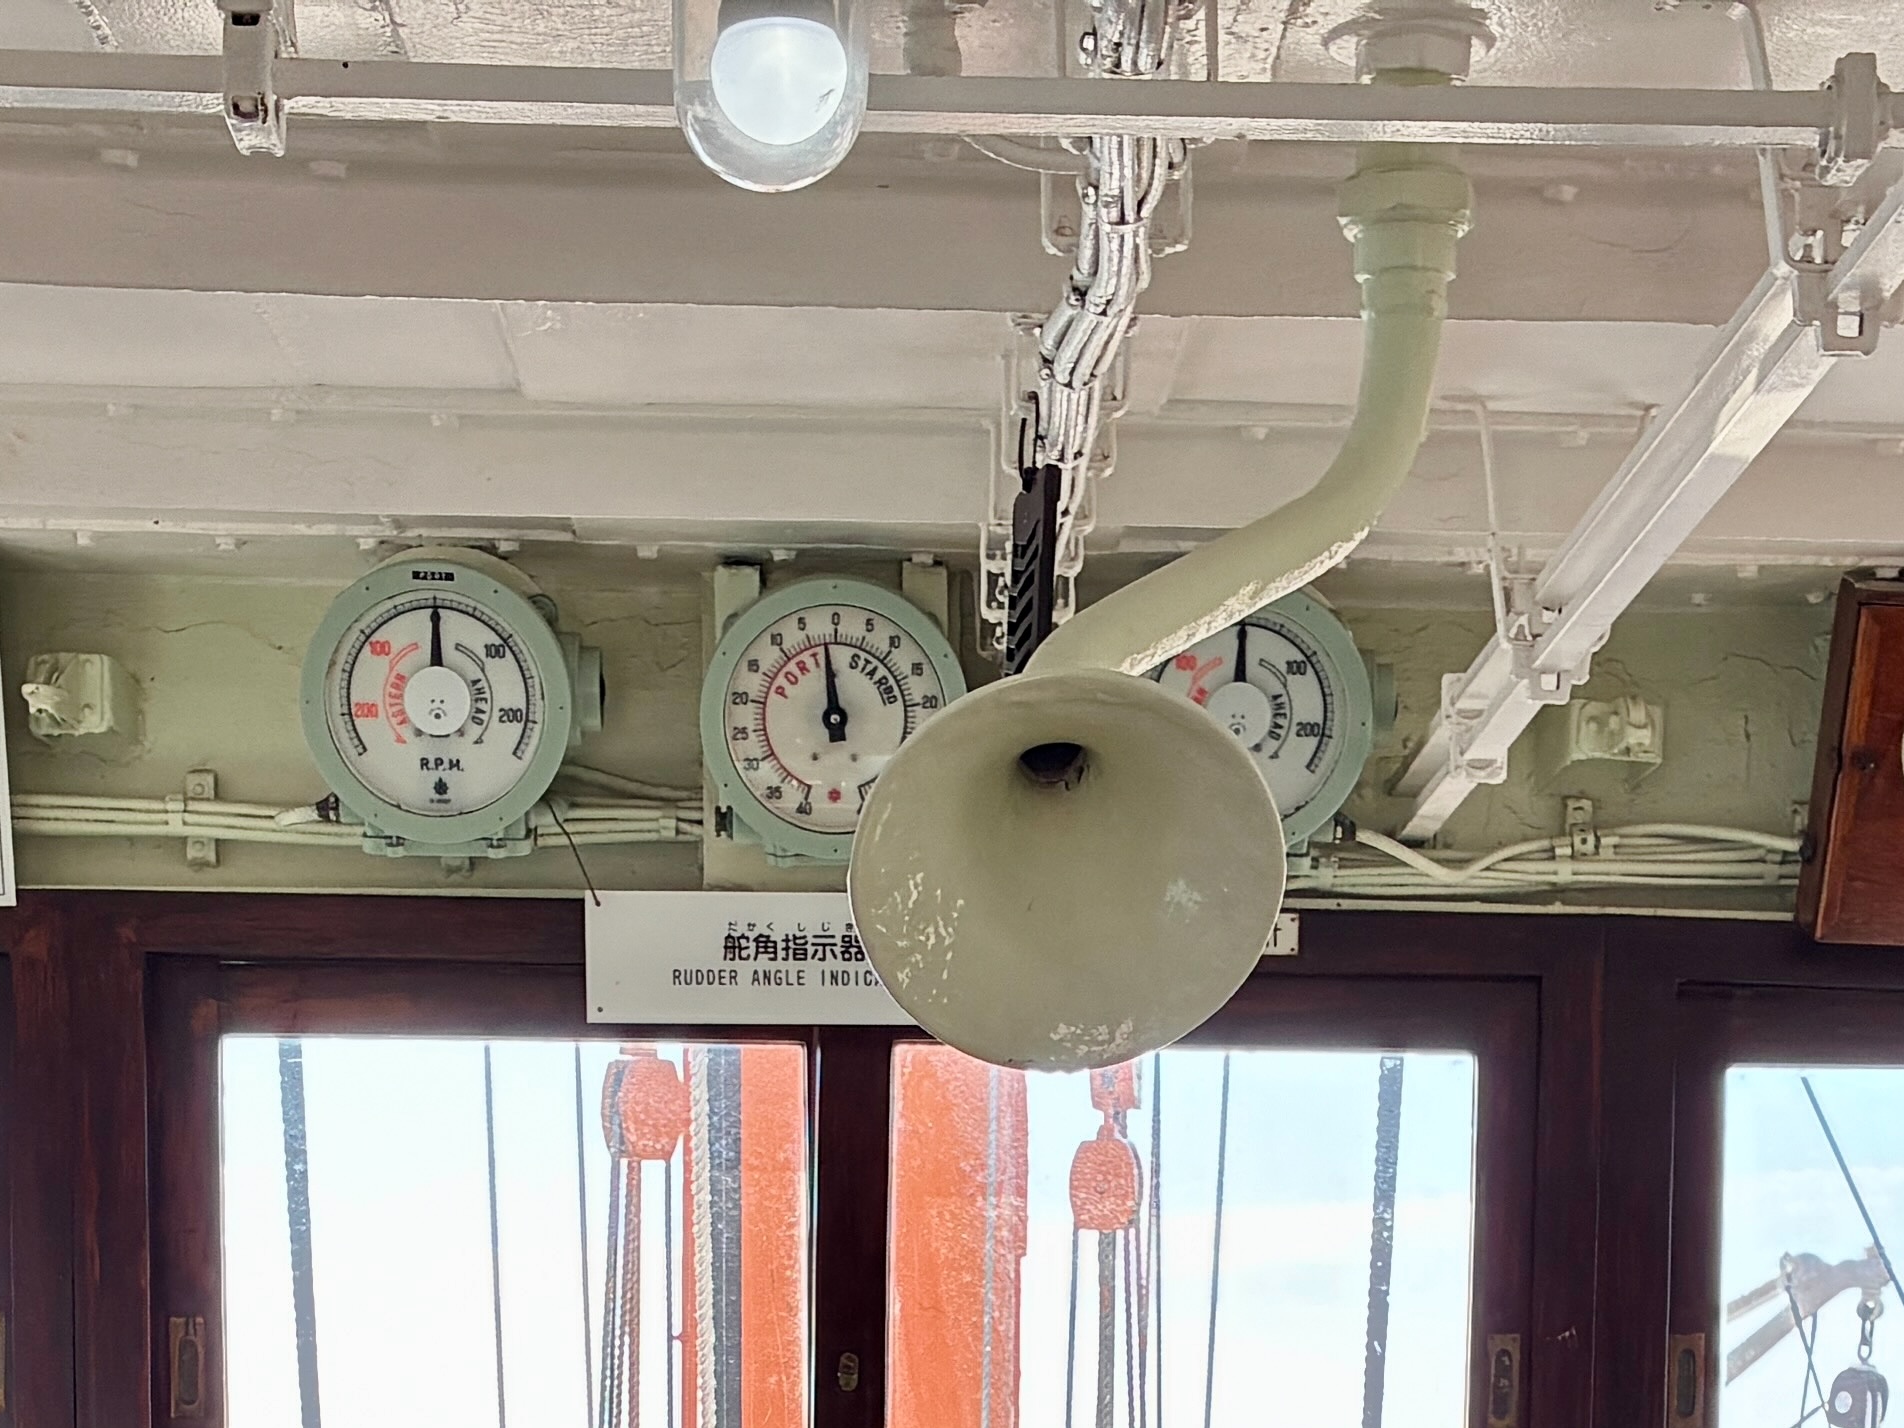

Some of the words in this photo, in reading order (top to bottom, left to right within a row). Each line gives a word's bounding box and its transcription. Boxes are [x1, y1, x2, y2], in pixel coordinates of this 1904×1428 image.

[798, 617, 807, 631] 5
[831, 612, 840, 626] 0
[865, 618, 875, 633] 5
[771, 633, 783, 647] 10
[889, 635, 901, 649] 10
[369, 640, 391, 656] 100
[484, 644, 506, 659] 100
[748, 659, 760, 673] 15
[911, 662, 924, 676] 15
[1286, 660, 1308, 675] 100
[775, 652, 821, 699] PORT
[470, 678, 489, 726] AHEAD
[732, 692, 749, 706] 20
[921, 695, 938, 709] 20
[353, 703, 379, 719] 200
[498, 708, 524, 724] 200
[1268, 693, 1288, 741] AHEAD
[732, 727, 749, 741] 25
[1296, 722, 1321, 737] 200
[743, 758, 760, 771] 30
[766, 786, 783, 800] 35
[796, 801, 812, 816] 40
[723, 933, 866, 962] 舵角指示器
[672, 969, 738, 986] RUDDER
[752, 969, 806, 986] ANGLE
